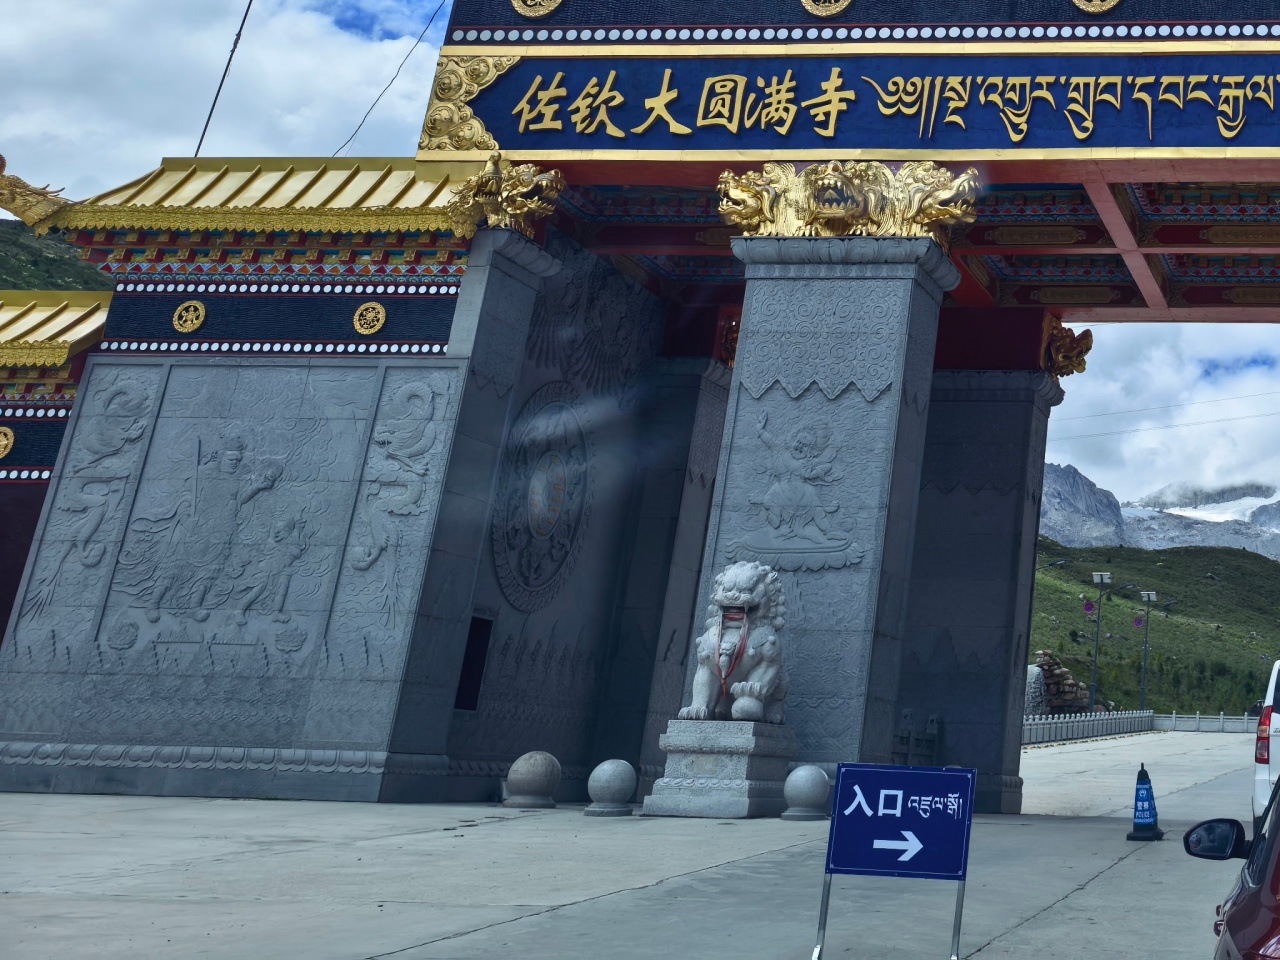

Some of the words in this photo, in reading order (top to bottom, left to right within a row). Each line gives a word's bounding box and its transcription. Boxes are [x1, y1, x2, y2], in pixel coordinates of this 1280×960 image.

[512, 67, 856, 138] 佐钦大圆满寺
[844, 785, 903, 817] 入口
